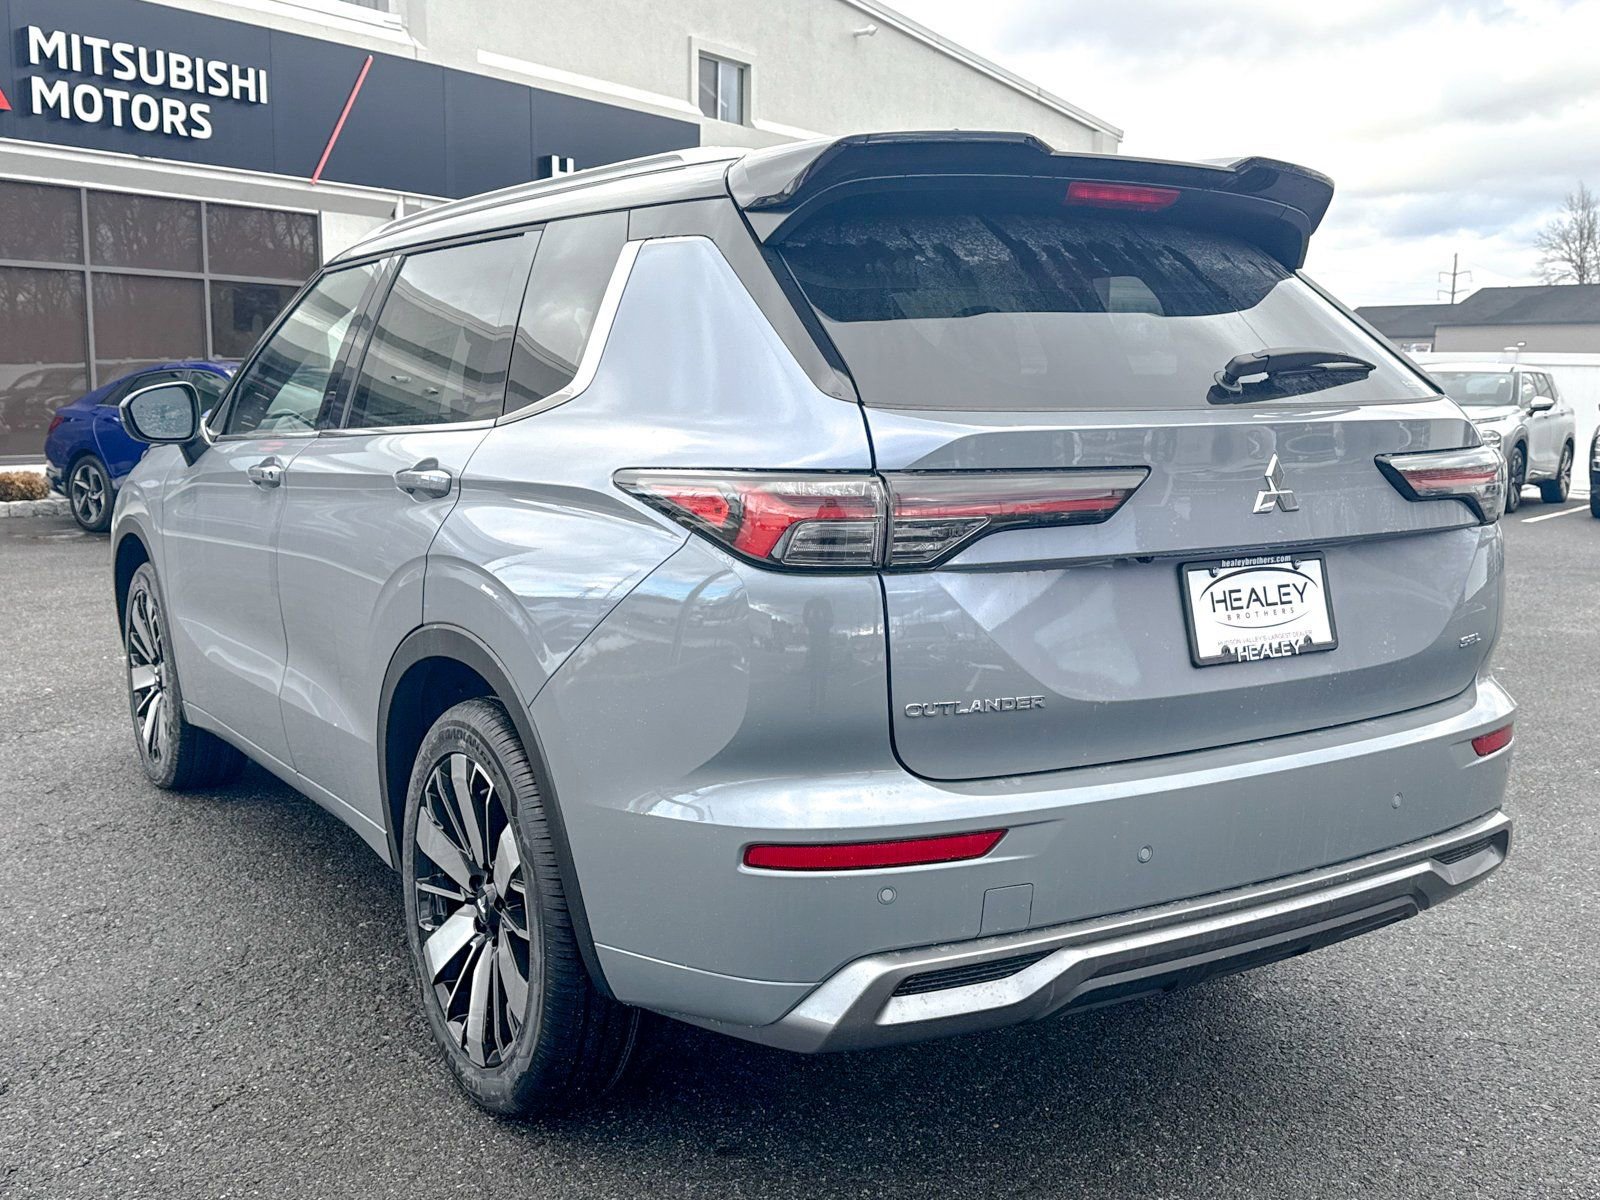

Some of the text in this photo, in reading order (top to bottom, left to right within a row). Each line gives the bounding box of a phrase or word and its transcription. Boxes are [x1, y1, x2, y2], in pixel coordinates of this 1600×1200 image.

[28, 25, 268, 104] MITSUBISHI
[31, 76, 213, 139] MOTORS
[1221, 555, 1291, 568] healeybrothers.com
[1210, 582, 1308, 613] HEALEY
[1226, 607, 1295, 621] BROTHERS
[1235, 639, 1300, 662] HEALEY
[905, 695, 1045, 718] OUTLANDER
